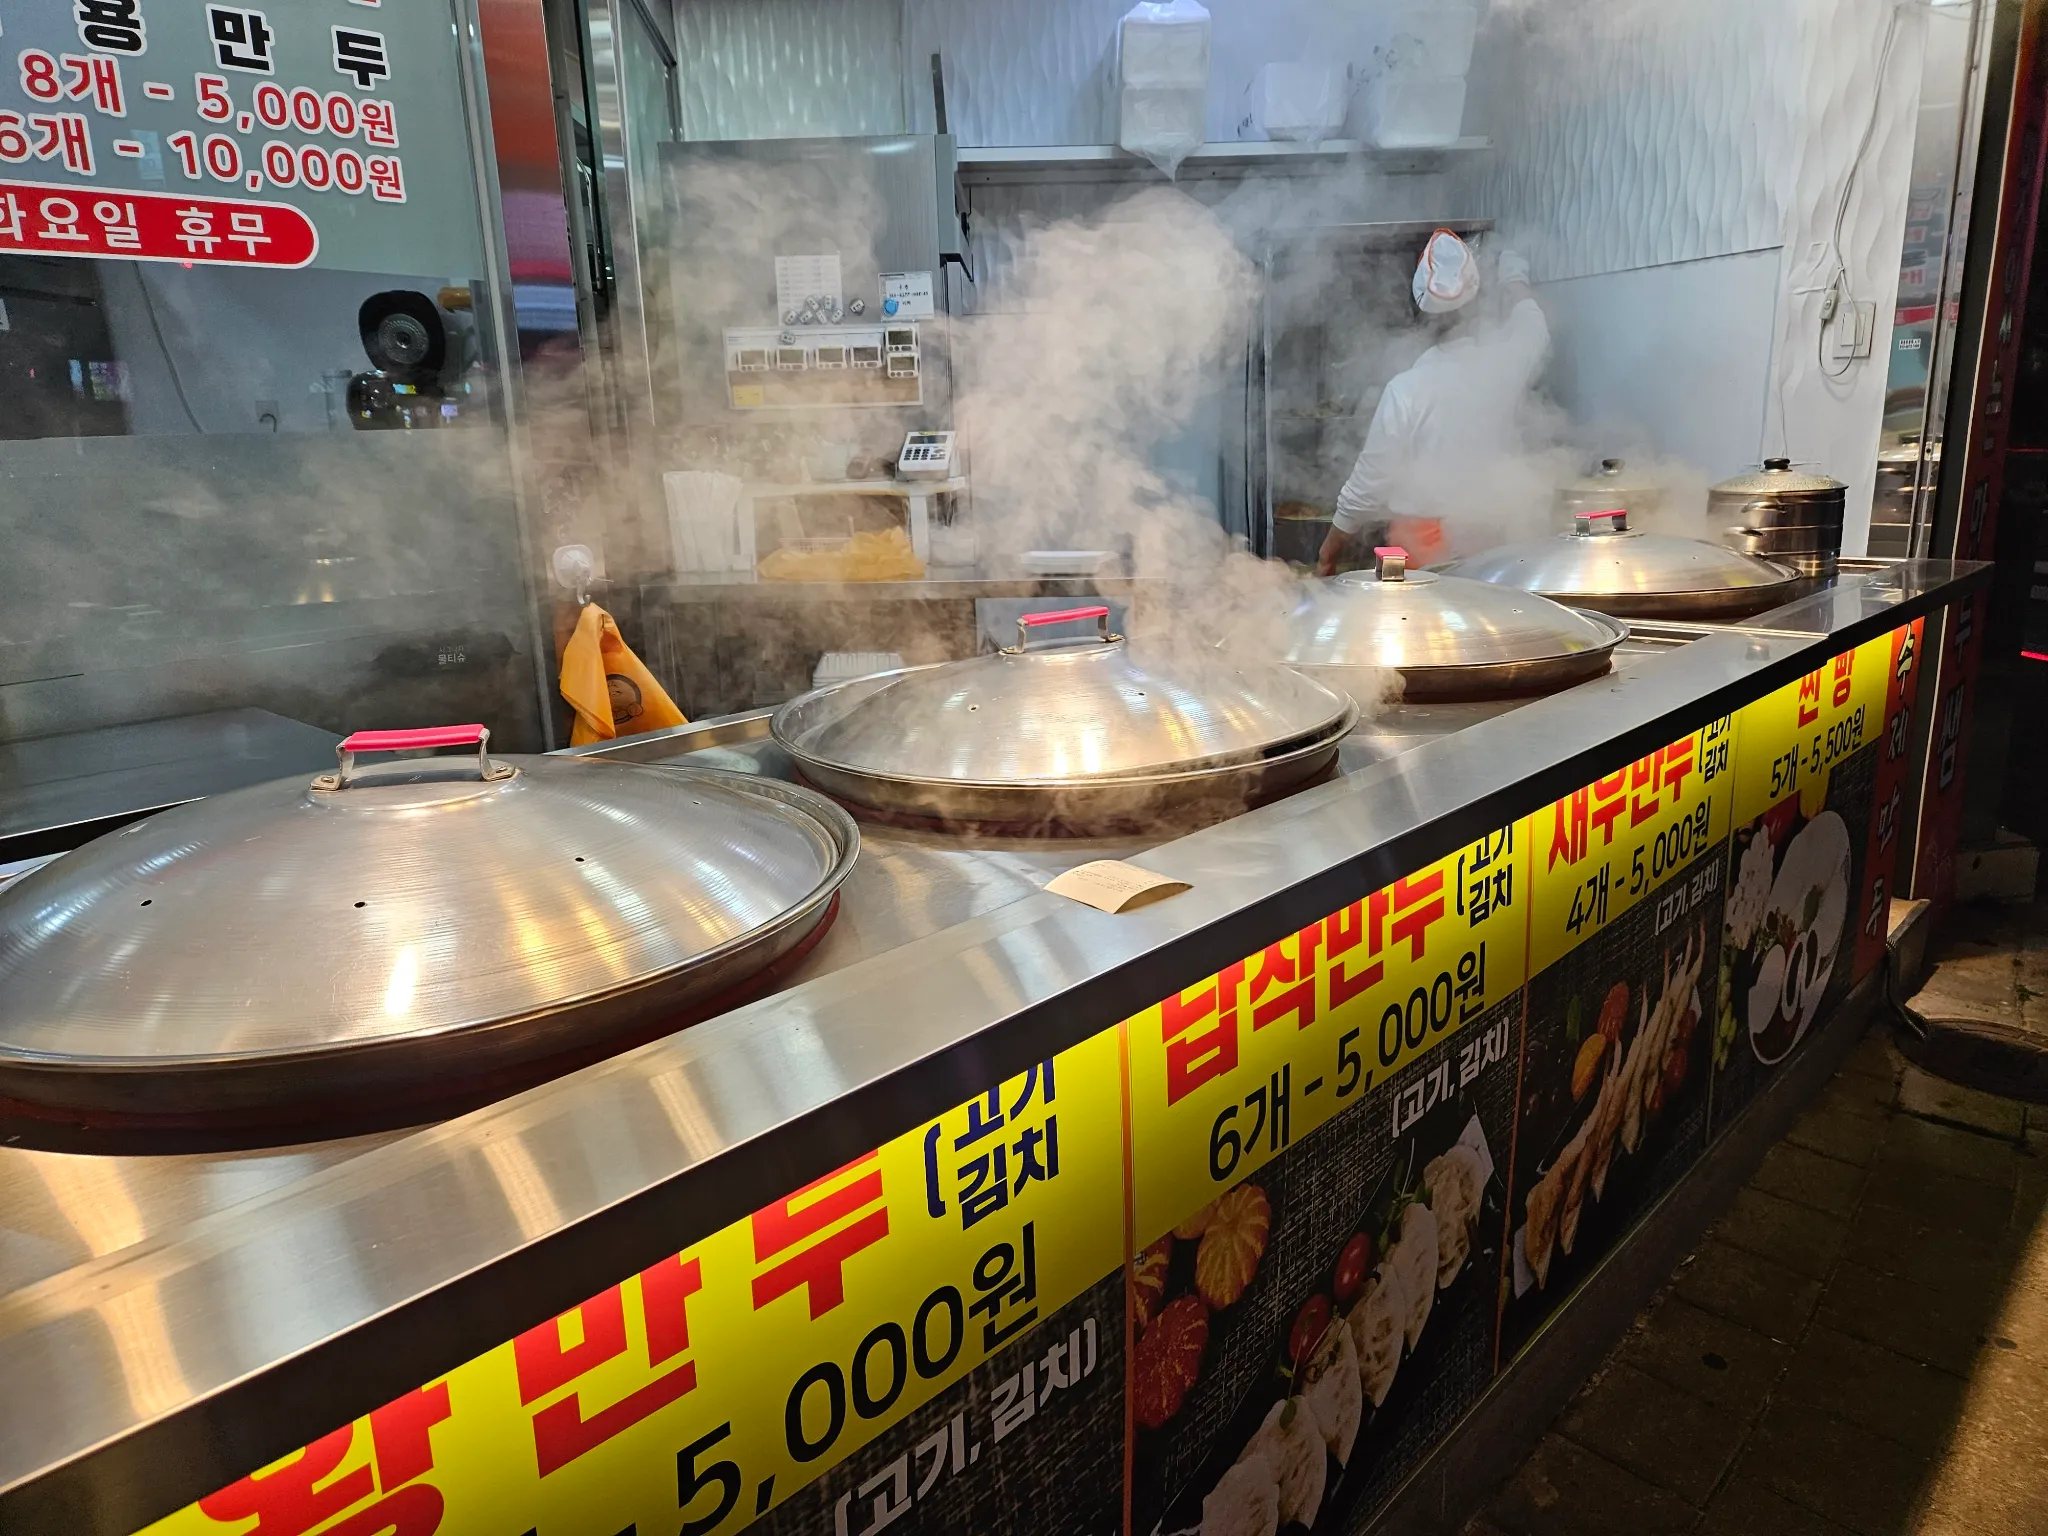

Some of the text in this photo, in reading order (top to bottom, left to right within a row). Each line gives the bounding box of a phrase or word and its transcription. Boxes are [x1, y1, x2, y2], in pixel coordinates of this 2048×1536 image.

[24, 54, 121, 113] 8개
[200, 78, 397, 144] 5,000원
[0, 115, 91, 171] 6개
[172, 135, 402, 199] 10,000원
[175, 206, 272, 256] 휴무
[1704, 739, 1728, 784] 김치
[1770, 744, 1799, 798] 5개
[1810, 704, 1865, 775] 5,500원
[1866, 623, 1916, 936] 수제만두
[1549, 737, 1693, 874] 새우만두
[1470, 863, 1512, 928] 김치
[1566, 862, 1610, 935] 4개
[1630, 795, 1711, 895] 5,000원
[1209, 1063, 1290, 1181] 6개
[1336, 941, 1485, 1098] 5,000원
[957, 1114, 1059, 1231] 김치
[676, 1220, 1038, 1536] 5,000원
